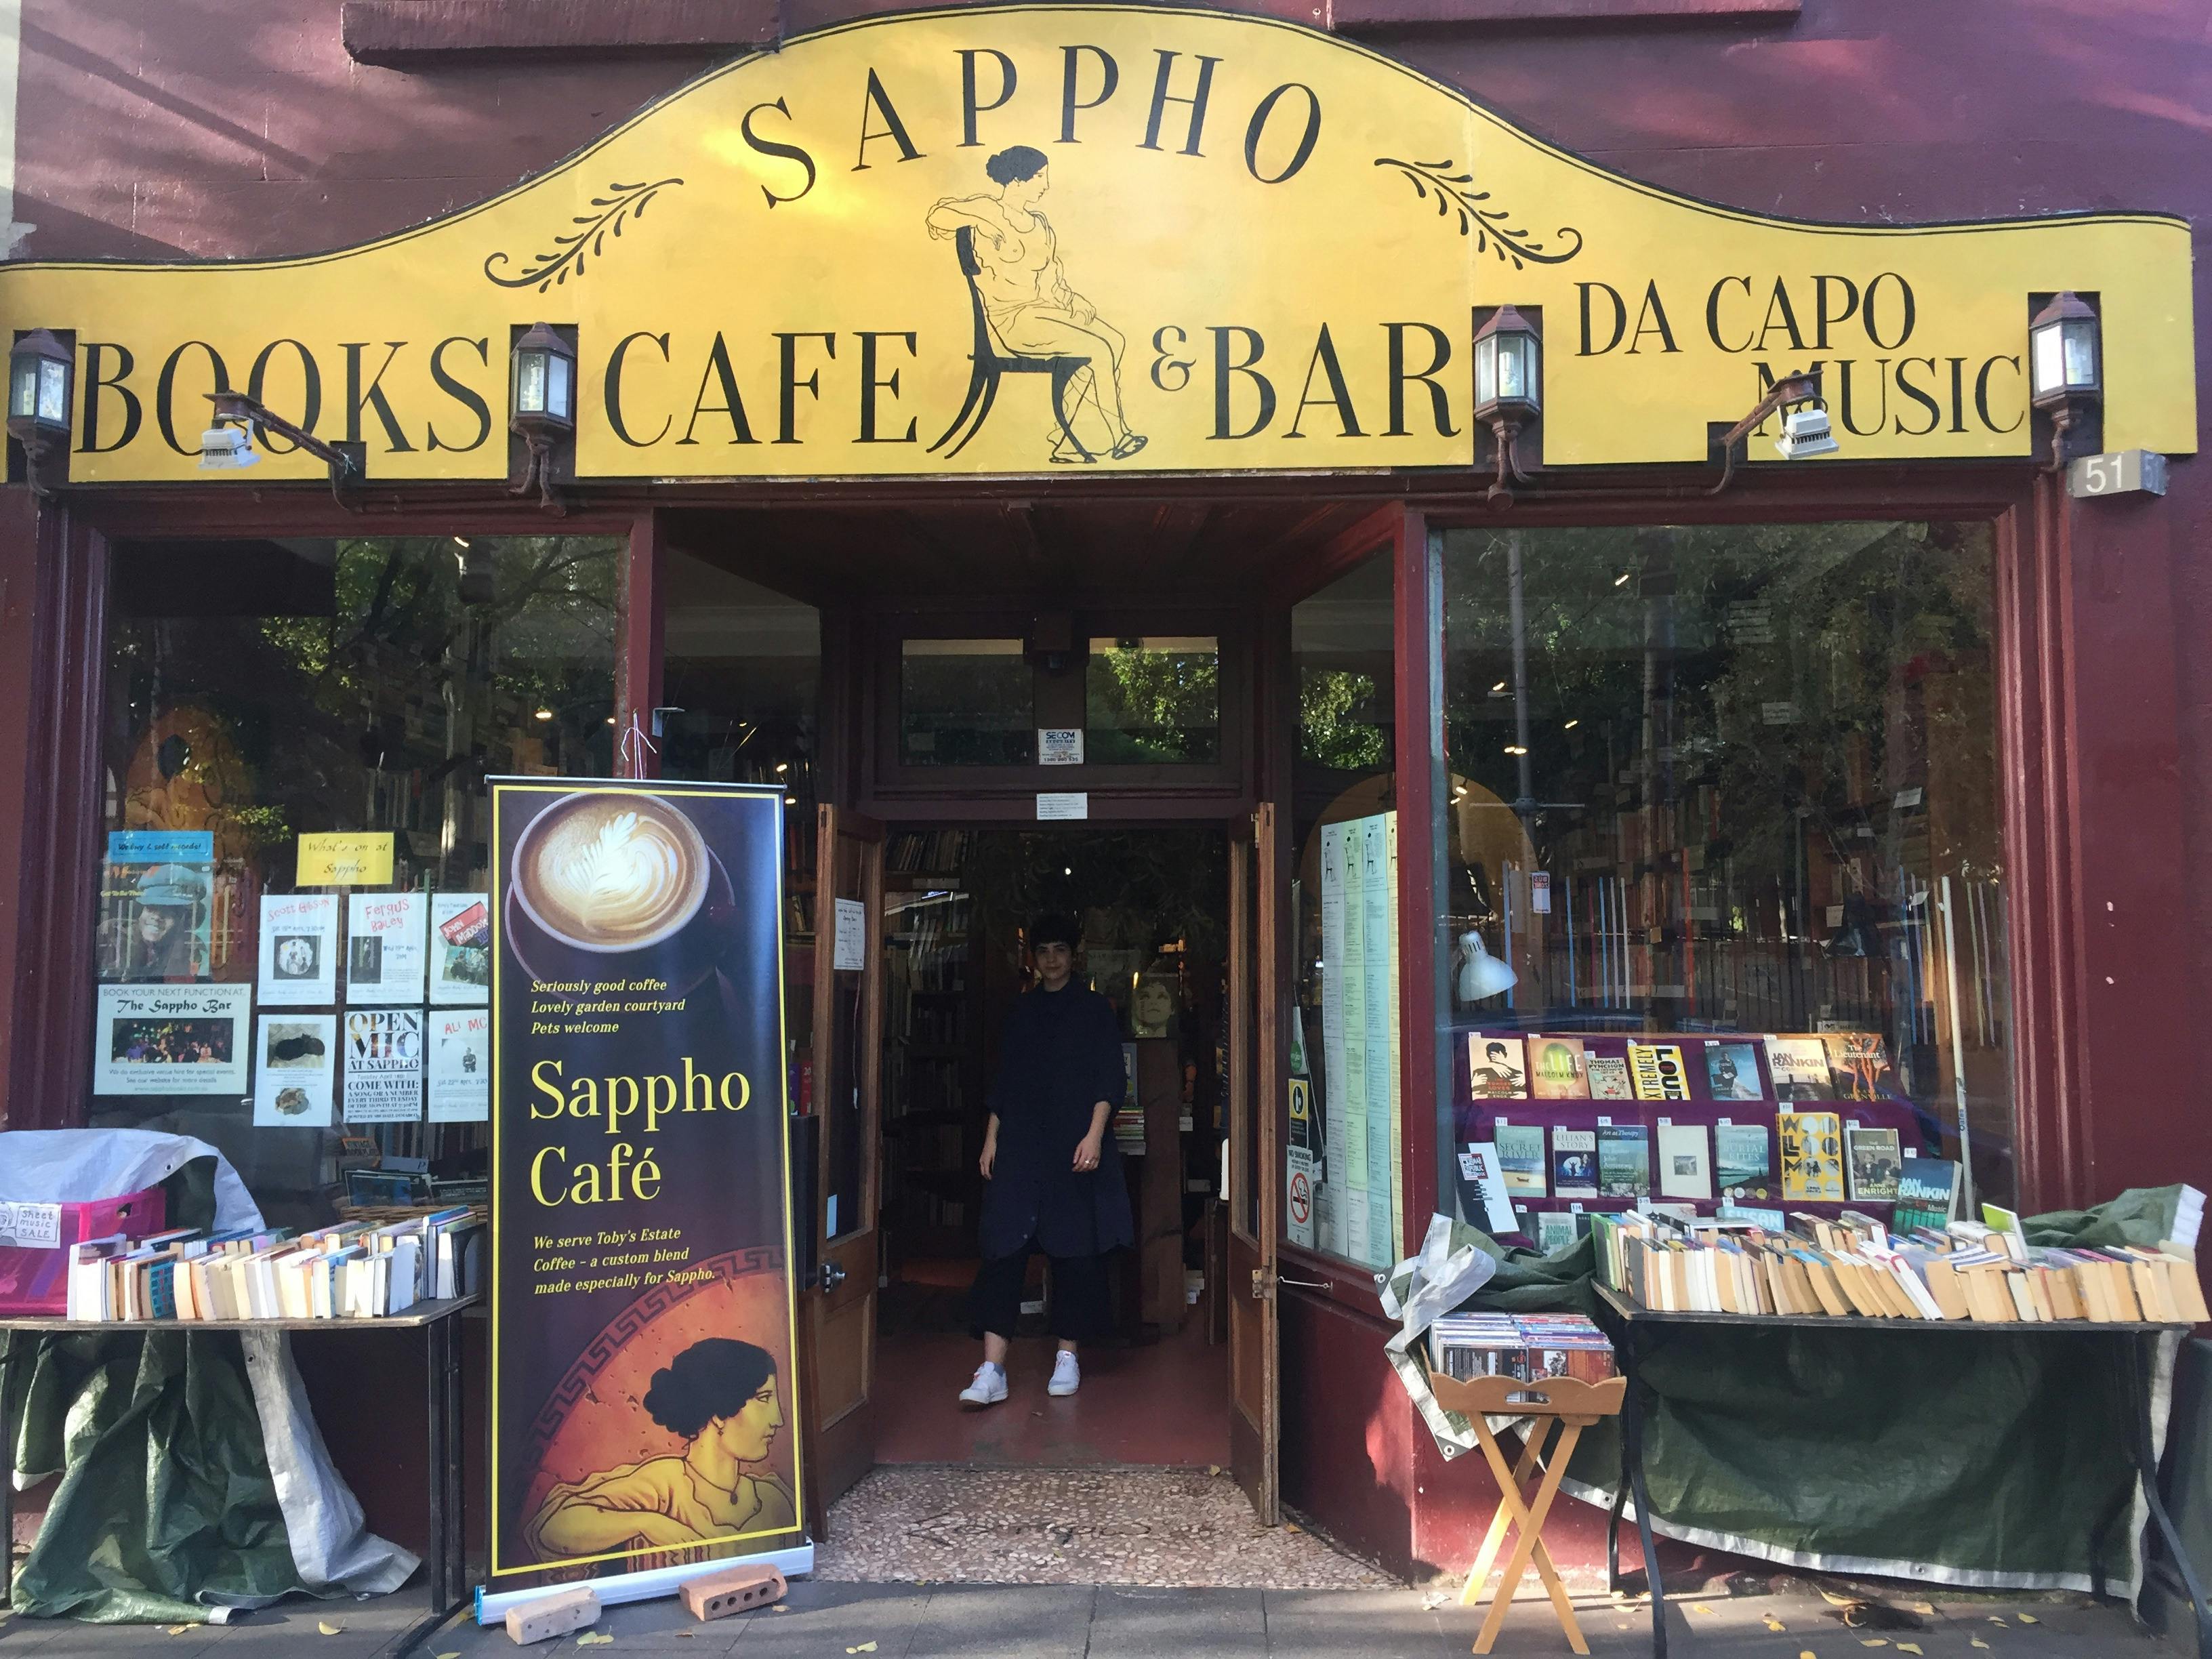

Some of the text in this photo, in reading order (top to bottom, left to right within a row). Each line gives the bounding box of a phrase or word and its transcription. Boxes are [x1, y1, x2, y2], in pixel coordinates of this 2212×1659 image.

[741, 44, 1322, 209] SAPPHO
[1573, 272, 1917, 357] DA CAPO
[72, 321, 1462, 457] BOOKS CAFE & BAR
[1751, 354, 2026, 438] MUSIC
[2085, 454, 2123, 493] 51
[1046, 731, 1076, 739] SECOM
[354, 843, 369, 852] on
[375, 842, 388, 852] at
[323, 859, 368, 881] Sappho
[103, 988, 232, 997] BOOK YOUR NEXT FUNCTION
[531, 979, 668, 995] Seriously good coffee
[117, 998, 232, 1014] The Sappho Bar
[531, 998, 687, 1016] Lovely garden courtyard
[348, 1011, 419, 1033] OPEN
[531, 1021, 620, 1034] Pets welcome
[348, 1031, 419, 1060] MIC
[1834, 1048, 1881, 1059] Lieutenant
[348, 1058, 419, 1071] AT SAPPHO
[1550, 1054, 1584, 1072] LIFE
[1771, 1057, 1824, 1068] RANKIN
[348, 1080, 419, 1090] COME WITH:
[531, 1057, 751, 1135] Sappho
[1618, 1129, 1639, 1138] Therapy
[1499, 1142, 1541, 1152] SECRET
[1561, 1141, 1589, 1149] STORY
[1723, 1144, 1763, 1153] BURIAL
[1501, 1151, 1540, 1160] RIVER
[1728, 1152, 1761, 1162] RITES
[531, 1142, 662, 1207] Café
[1857, 1187, 1898, 1195] ENRIGHT
[1897, 1183, 1951, 1201] RANKIN
[1927, 1204, 1948, 1213] Music
[21, 1210, 54, 1221] Sheet
[20, 1219, 52, 1229] music
[1545, 1225, 1573, 1236] ANIMAL
[20, 1228, 51, 1239] SALE
[534, 1227, 681, 1250] We serve Toby's Estate
[1545, 1234, 1571, 1246] PEOPLE
[533, 1256, 575, 1273] Coffee
[590, 1257, 598, 1268] a
[602, 1252, 649, 1266] custom
[653, 1247, 690, 1263] blend
[534, 1267, 716, 1295] made especially for Sappho.
